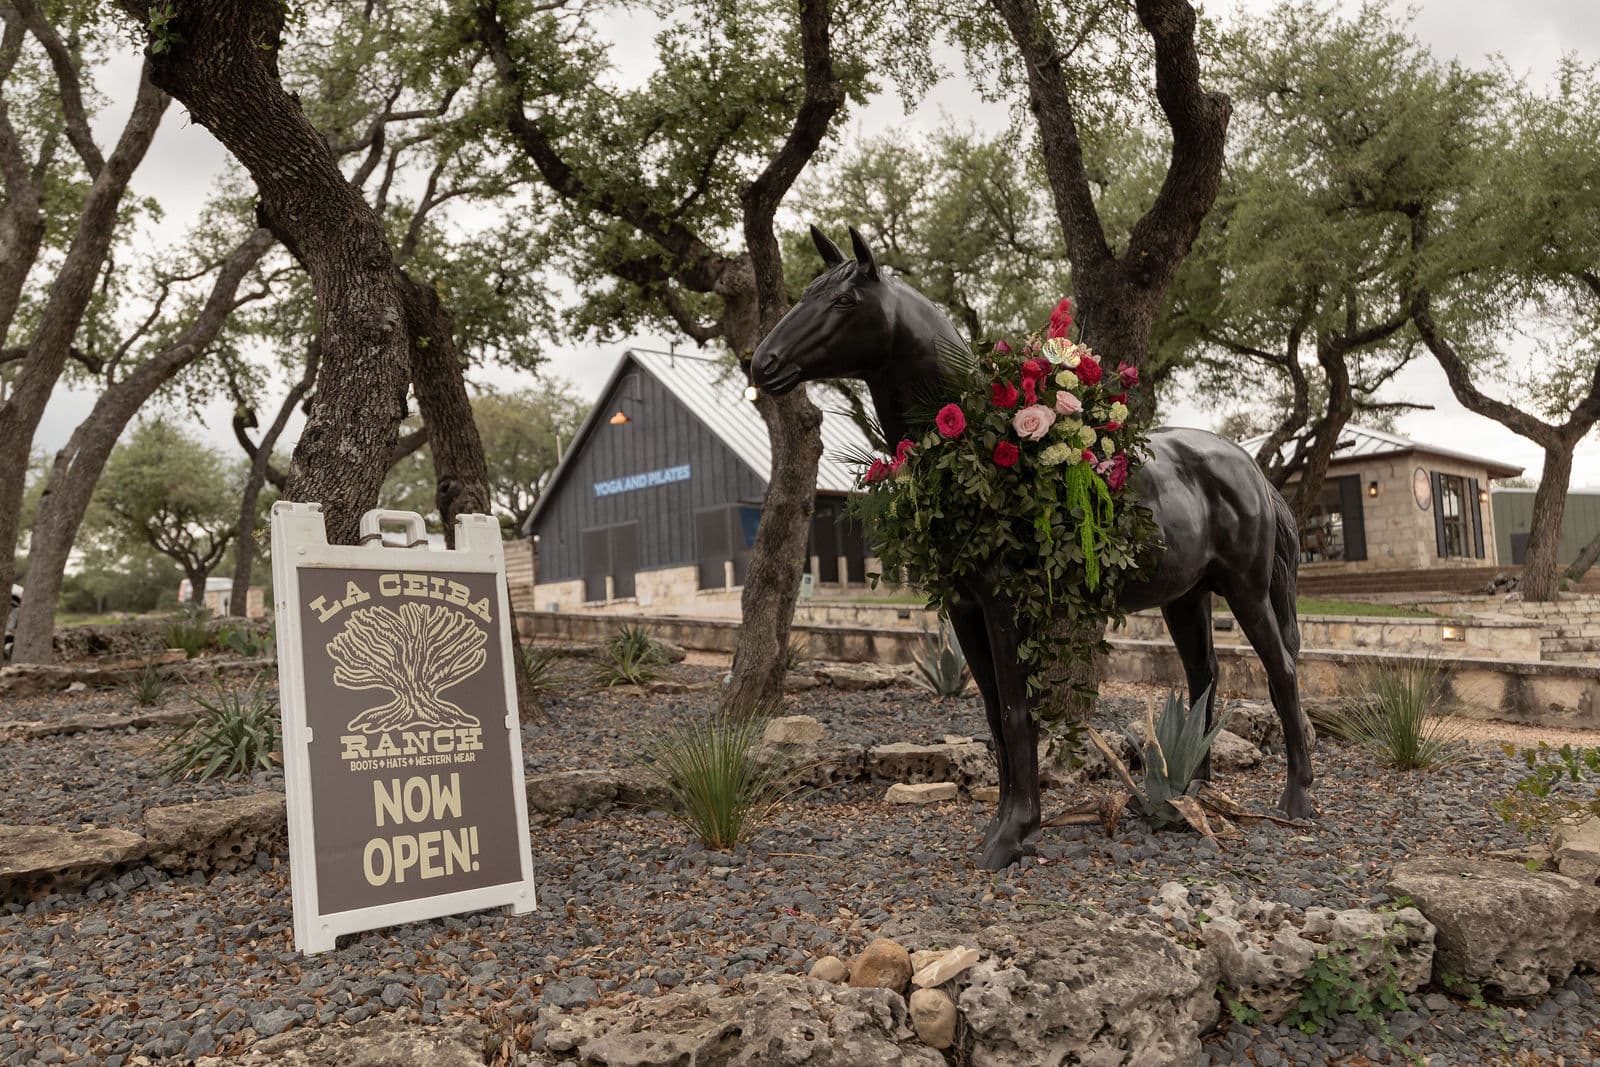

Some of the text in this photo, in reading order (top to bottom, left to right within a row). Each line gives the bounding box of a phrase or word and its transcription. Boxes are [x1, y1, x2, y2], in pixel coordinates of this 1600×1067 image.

[594, 464, 690, 496] YOGA AND PILATES
[309, 573, 493, 623] LA CEIBA
[340, 728, 484, 760] RANCH
[351, 753, 475, 771] BOOTS HATS WESTERN WEAR
[373, 772, 462, 827] NOW
[363, 826, 480, 886] OPEN!
